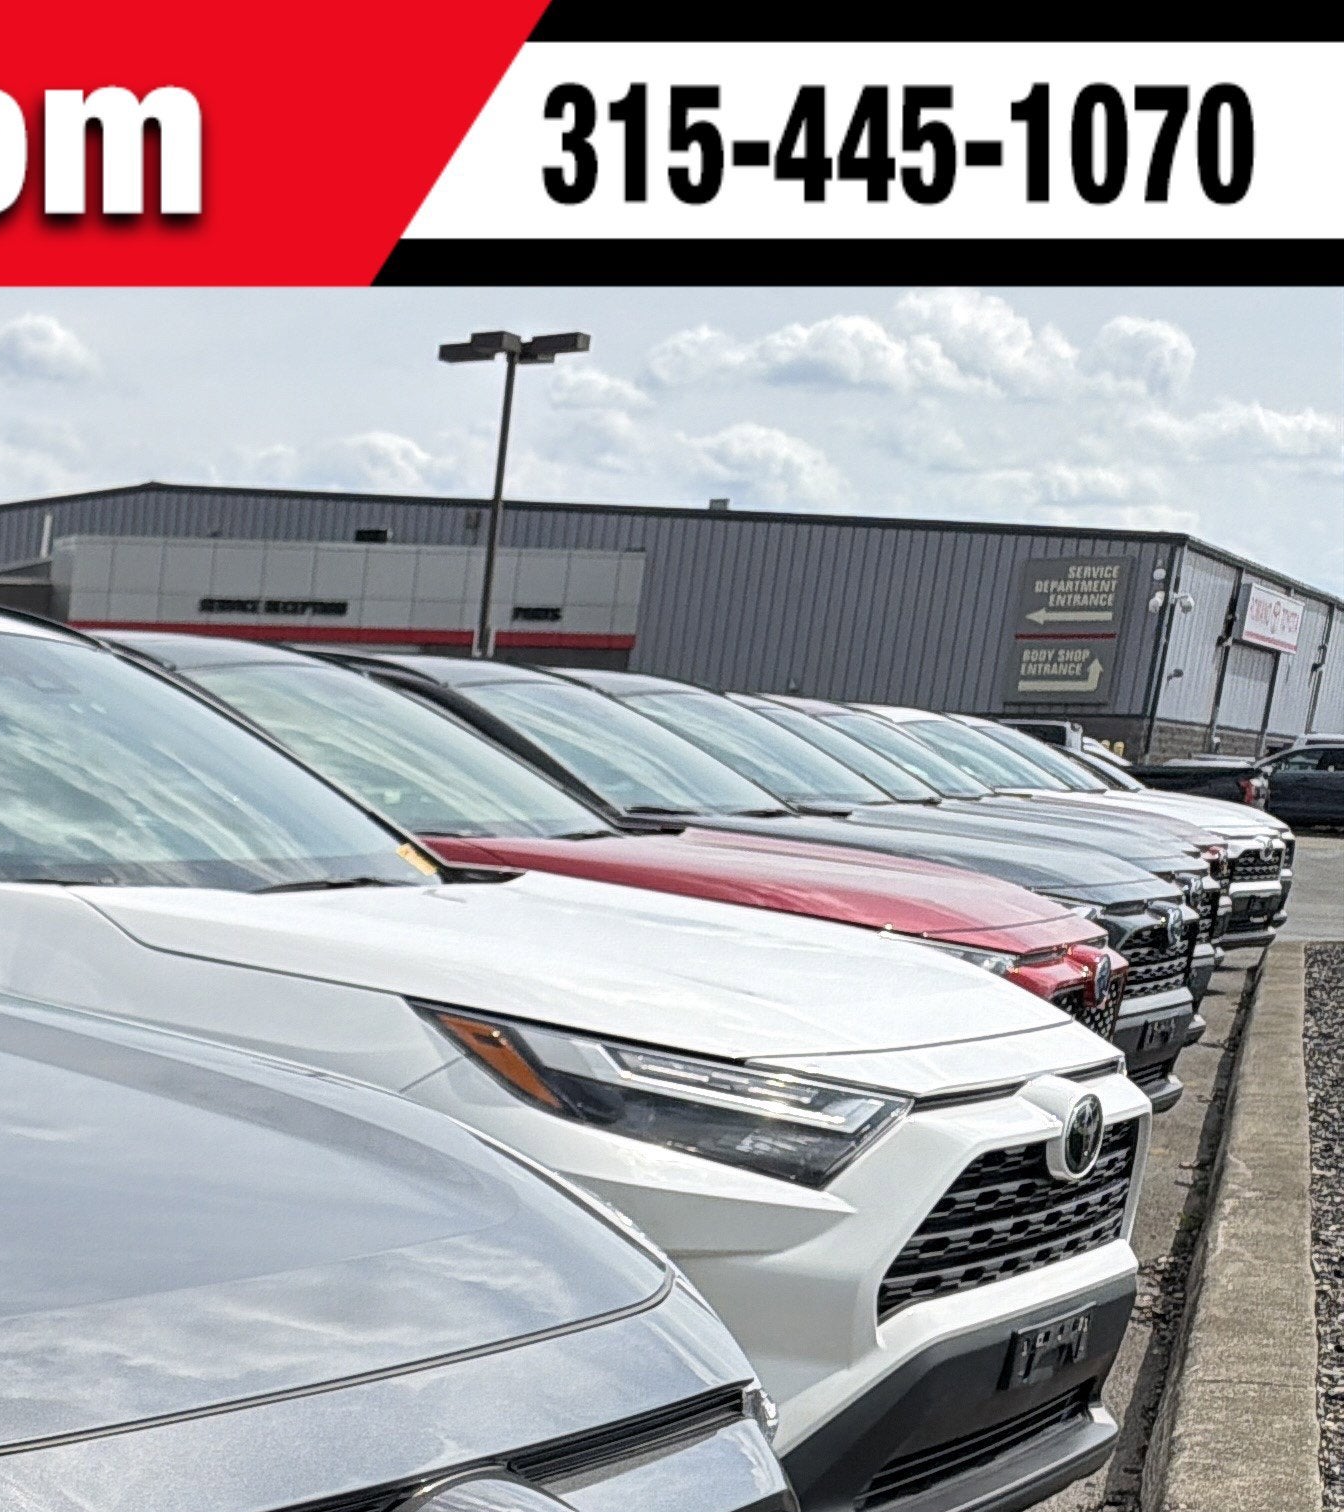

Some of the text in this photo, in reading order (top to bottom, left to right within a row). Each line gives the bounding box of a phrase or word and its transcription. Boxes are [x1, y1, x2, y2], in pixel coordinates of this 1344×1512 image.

[1068, 566, 1120, 579] SERVICE
[1034, 580, 1118, 593] DEPARTMENT
[1049, 593, 1115, 607] ENTRANCE
[1022, 649, 1091, 662] BODY SHOP
[1020, 662, 1083, 676] ENTRANCE
